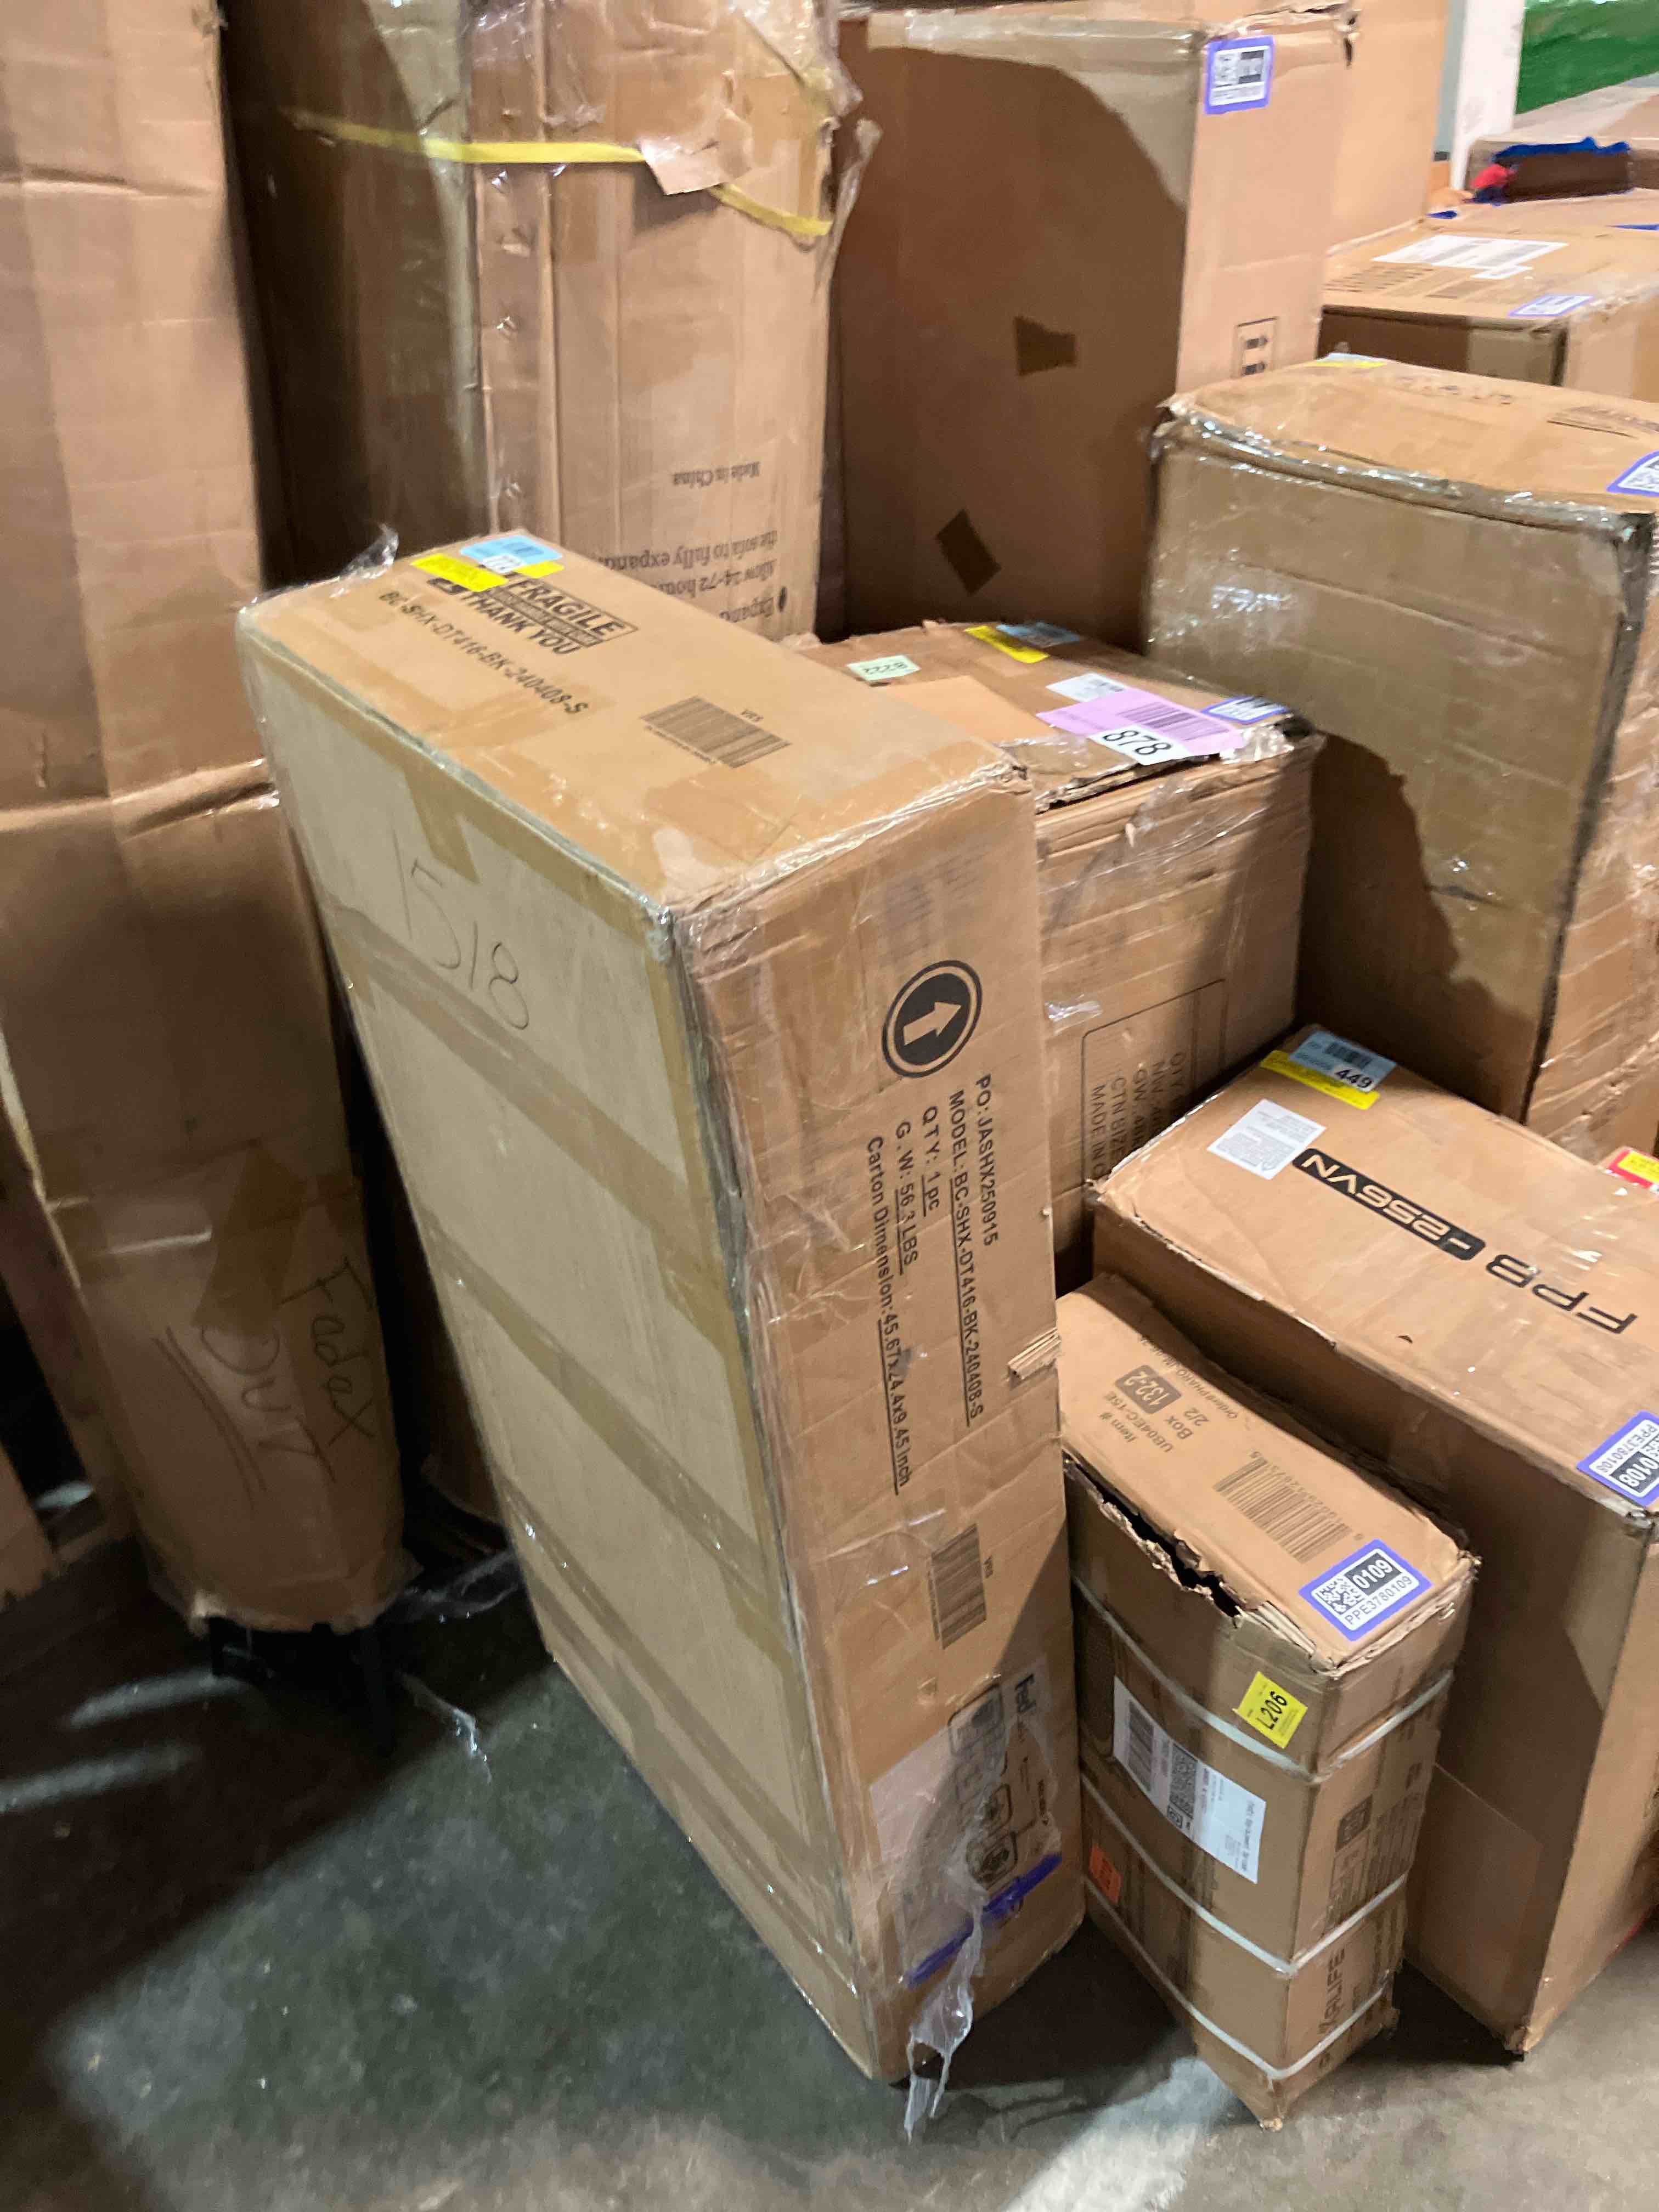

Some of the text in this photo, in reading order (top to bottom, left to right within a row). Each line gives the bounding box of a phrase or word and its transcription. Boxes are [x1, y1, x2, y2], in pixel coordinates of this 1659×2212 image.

[673, 545, 712, 569] fully
[506, 576, 627, 636] FRAGILE
[459, 589, 535, 635] THANK
[526, 624, 581, 656] YOU
[1103, 729, 1172, 756] 878
[1333, 1069, 1374, 1090] 449
[1091, 1084, 1107, 1138] MADE
[1091, 1143, 1106, 1161] IN
[866, 1136, 884, 1203] Carton
[1162, 1417, 1194, 1441] Box
[1182, 1406, 1211, 1427] 2/2
[1619, 1457, 1659, 1488] 0108
[1352, 1559, 1393, 1590] 0109
[1264, 1690, 1289, 1730] L206
